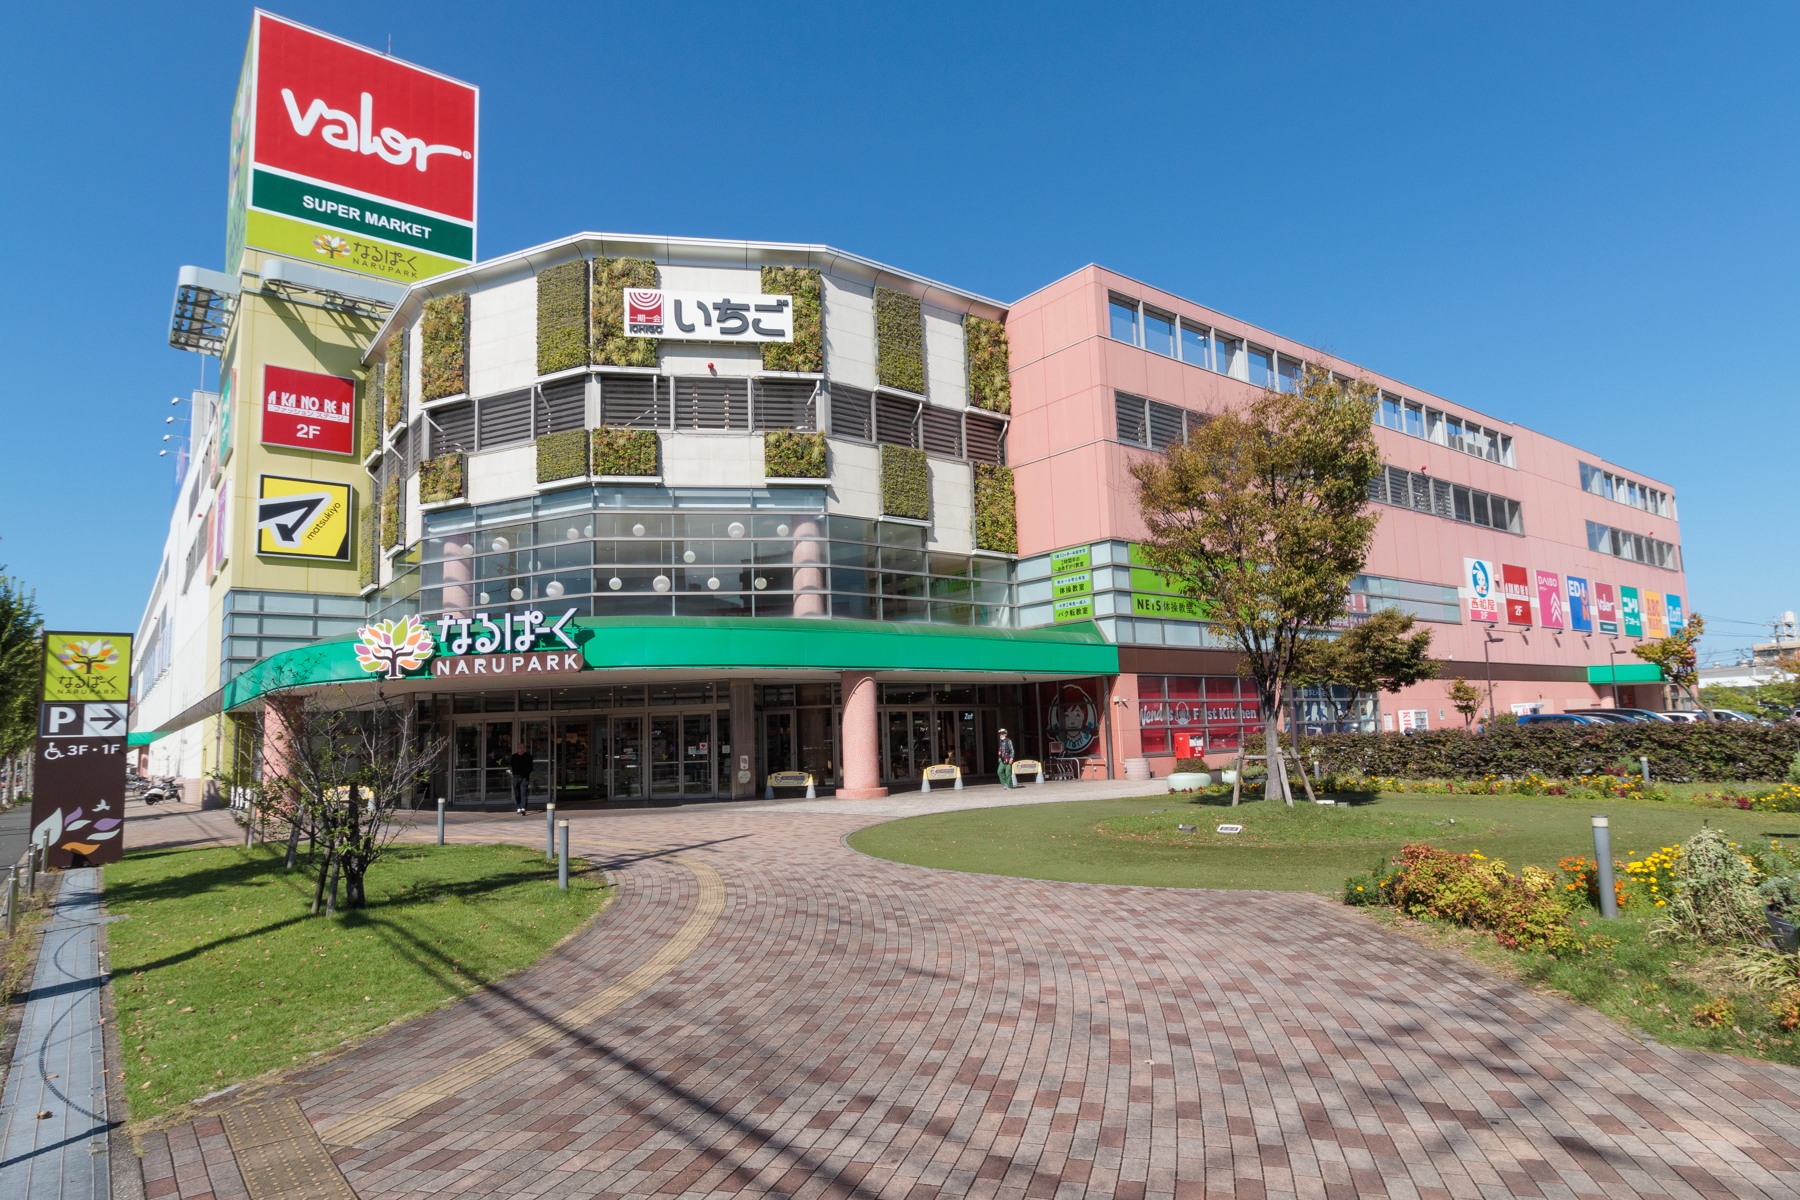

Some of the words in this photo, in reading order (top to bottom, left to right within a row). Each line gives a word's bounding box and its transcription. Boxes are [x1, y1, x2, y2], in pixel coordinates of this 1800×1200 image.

[281, 88, 462, 172] valor
[302, 195, 361, 222] SUPER
[364, 213, 432, 240] MARKET
[353, 242, 418, 272] なるぱーく
[352, 258, 418, 279] NARUPARK
[630, 314, 661, 323] 一期一会
[673, 298, 789, 337] いちご
[273, 406, 314, 417] ファッション
[316, 412, 344, 421] ステージ
[296, 424, 321, 439] 2F
[307, 501, 342, 541] matsukiyo
[1059, 583, 1085, 594] 体操教室
[1538, 576, 1558, 587] DAISO
[1058, 607, 1088, 617] バク転教室
[1163, 601, 1194, 614] 体操教室
[1471, 597, 1495, 611] 西松屋
[1514, 605, 1523, 616] 2F
[1622, 597, 1639, 614] ニトリ
[1646, 598, 1661, 617] ABC
[1480, 611, 1488, 620] 2F
[1668, 605, 1681, 623] Zoff
[436, 607, 580, 655] なるぱーく
[436, 653, 579, 676] NARUPARK
[58, 675, 118, 689] なるぱーく
[49, 707, 76, 733] P
[1192, 708, 1218, 720] Fst
